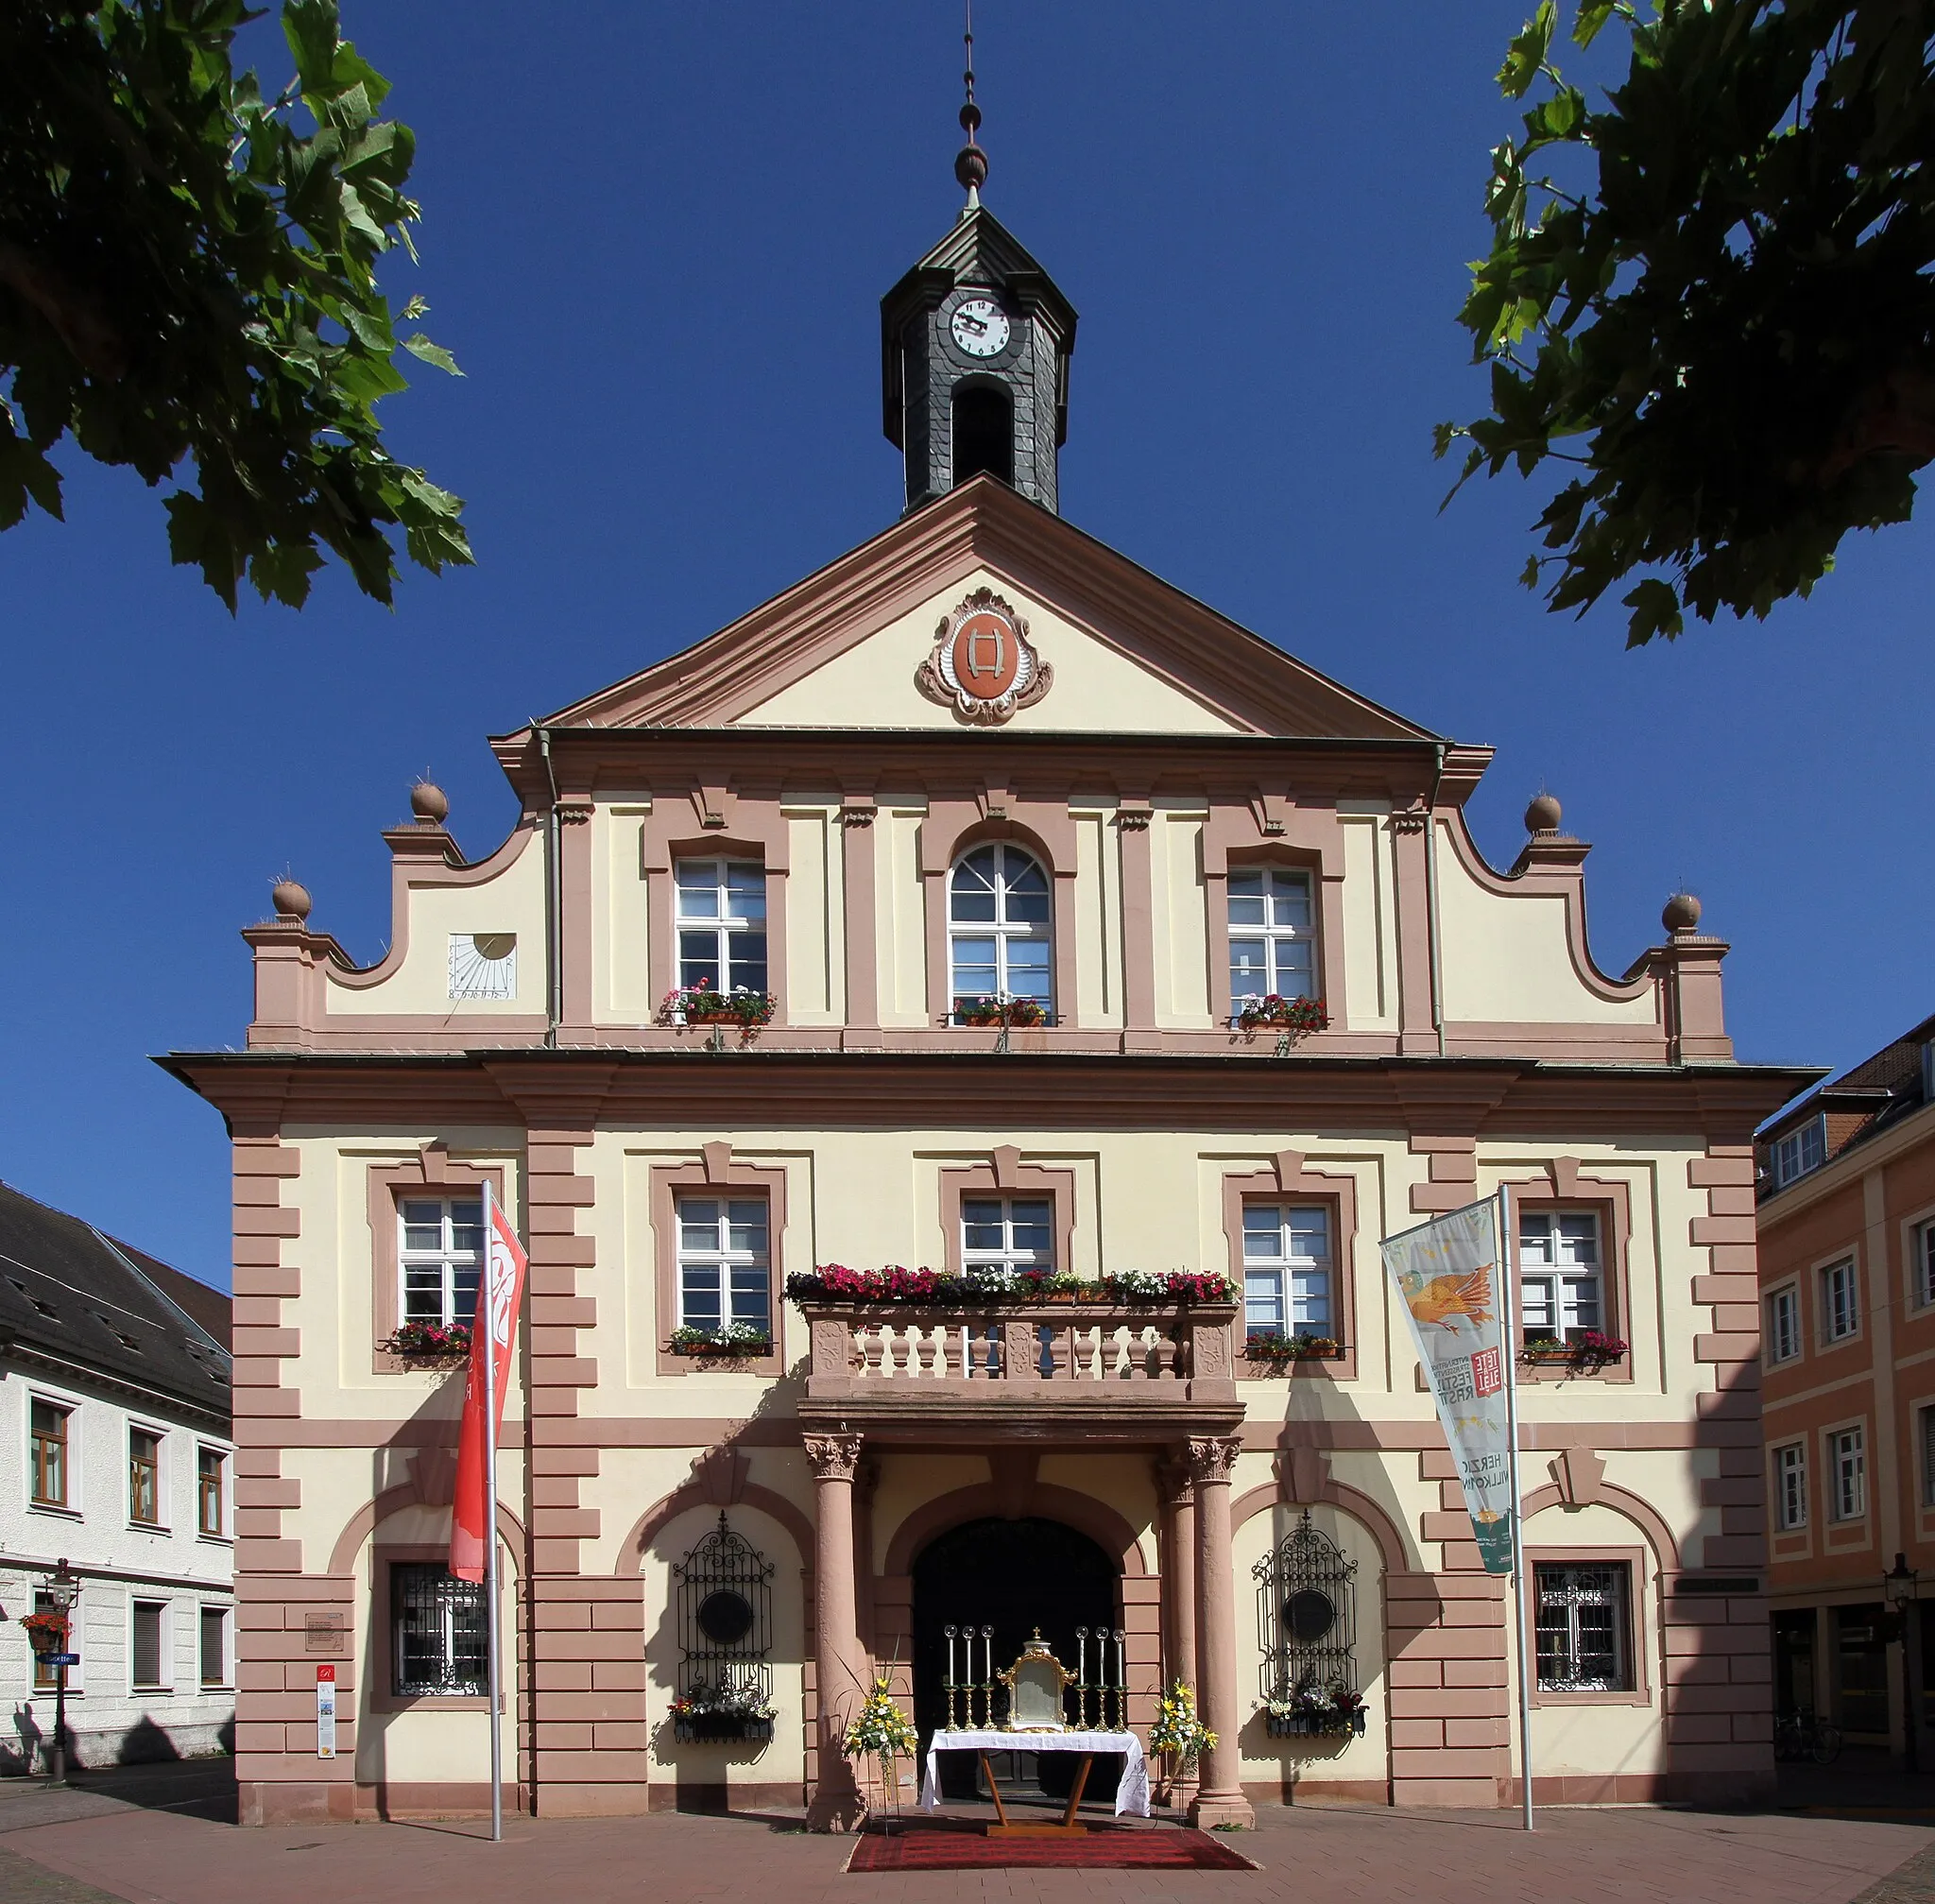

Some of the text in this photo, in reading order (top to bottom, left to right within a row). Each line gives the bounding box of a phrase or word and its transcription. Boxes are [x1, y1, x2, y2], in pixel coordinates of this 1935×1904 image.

[958, 334, 963, 343] 8
[968, 343, 971, 352] 7
[449, 989, 454, 999] 8
